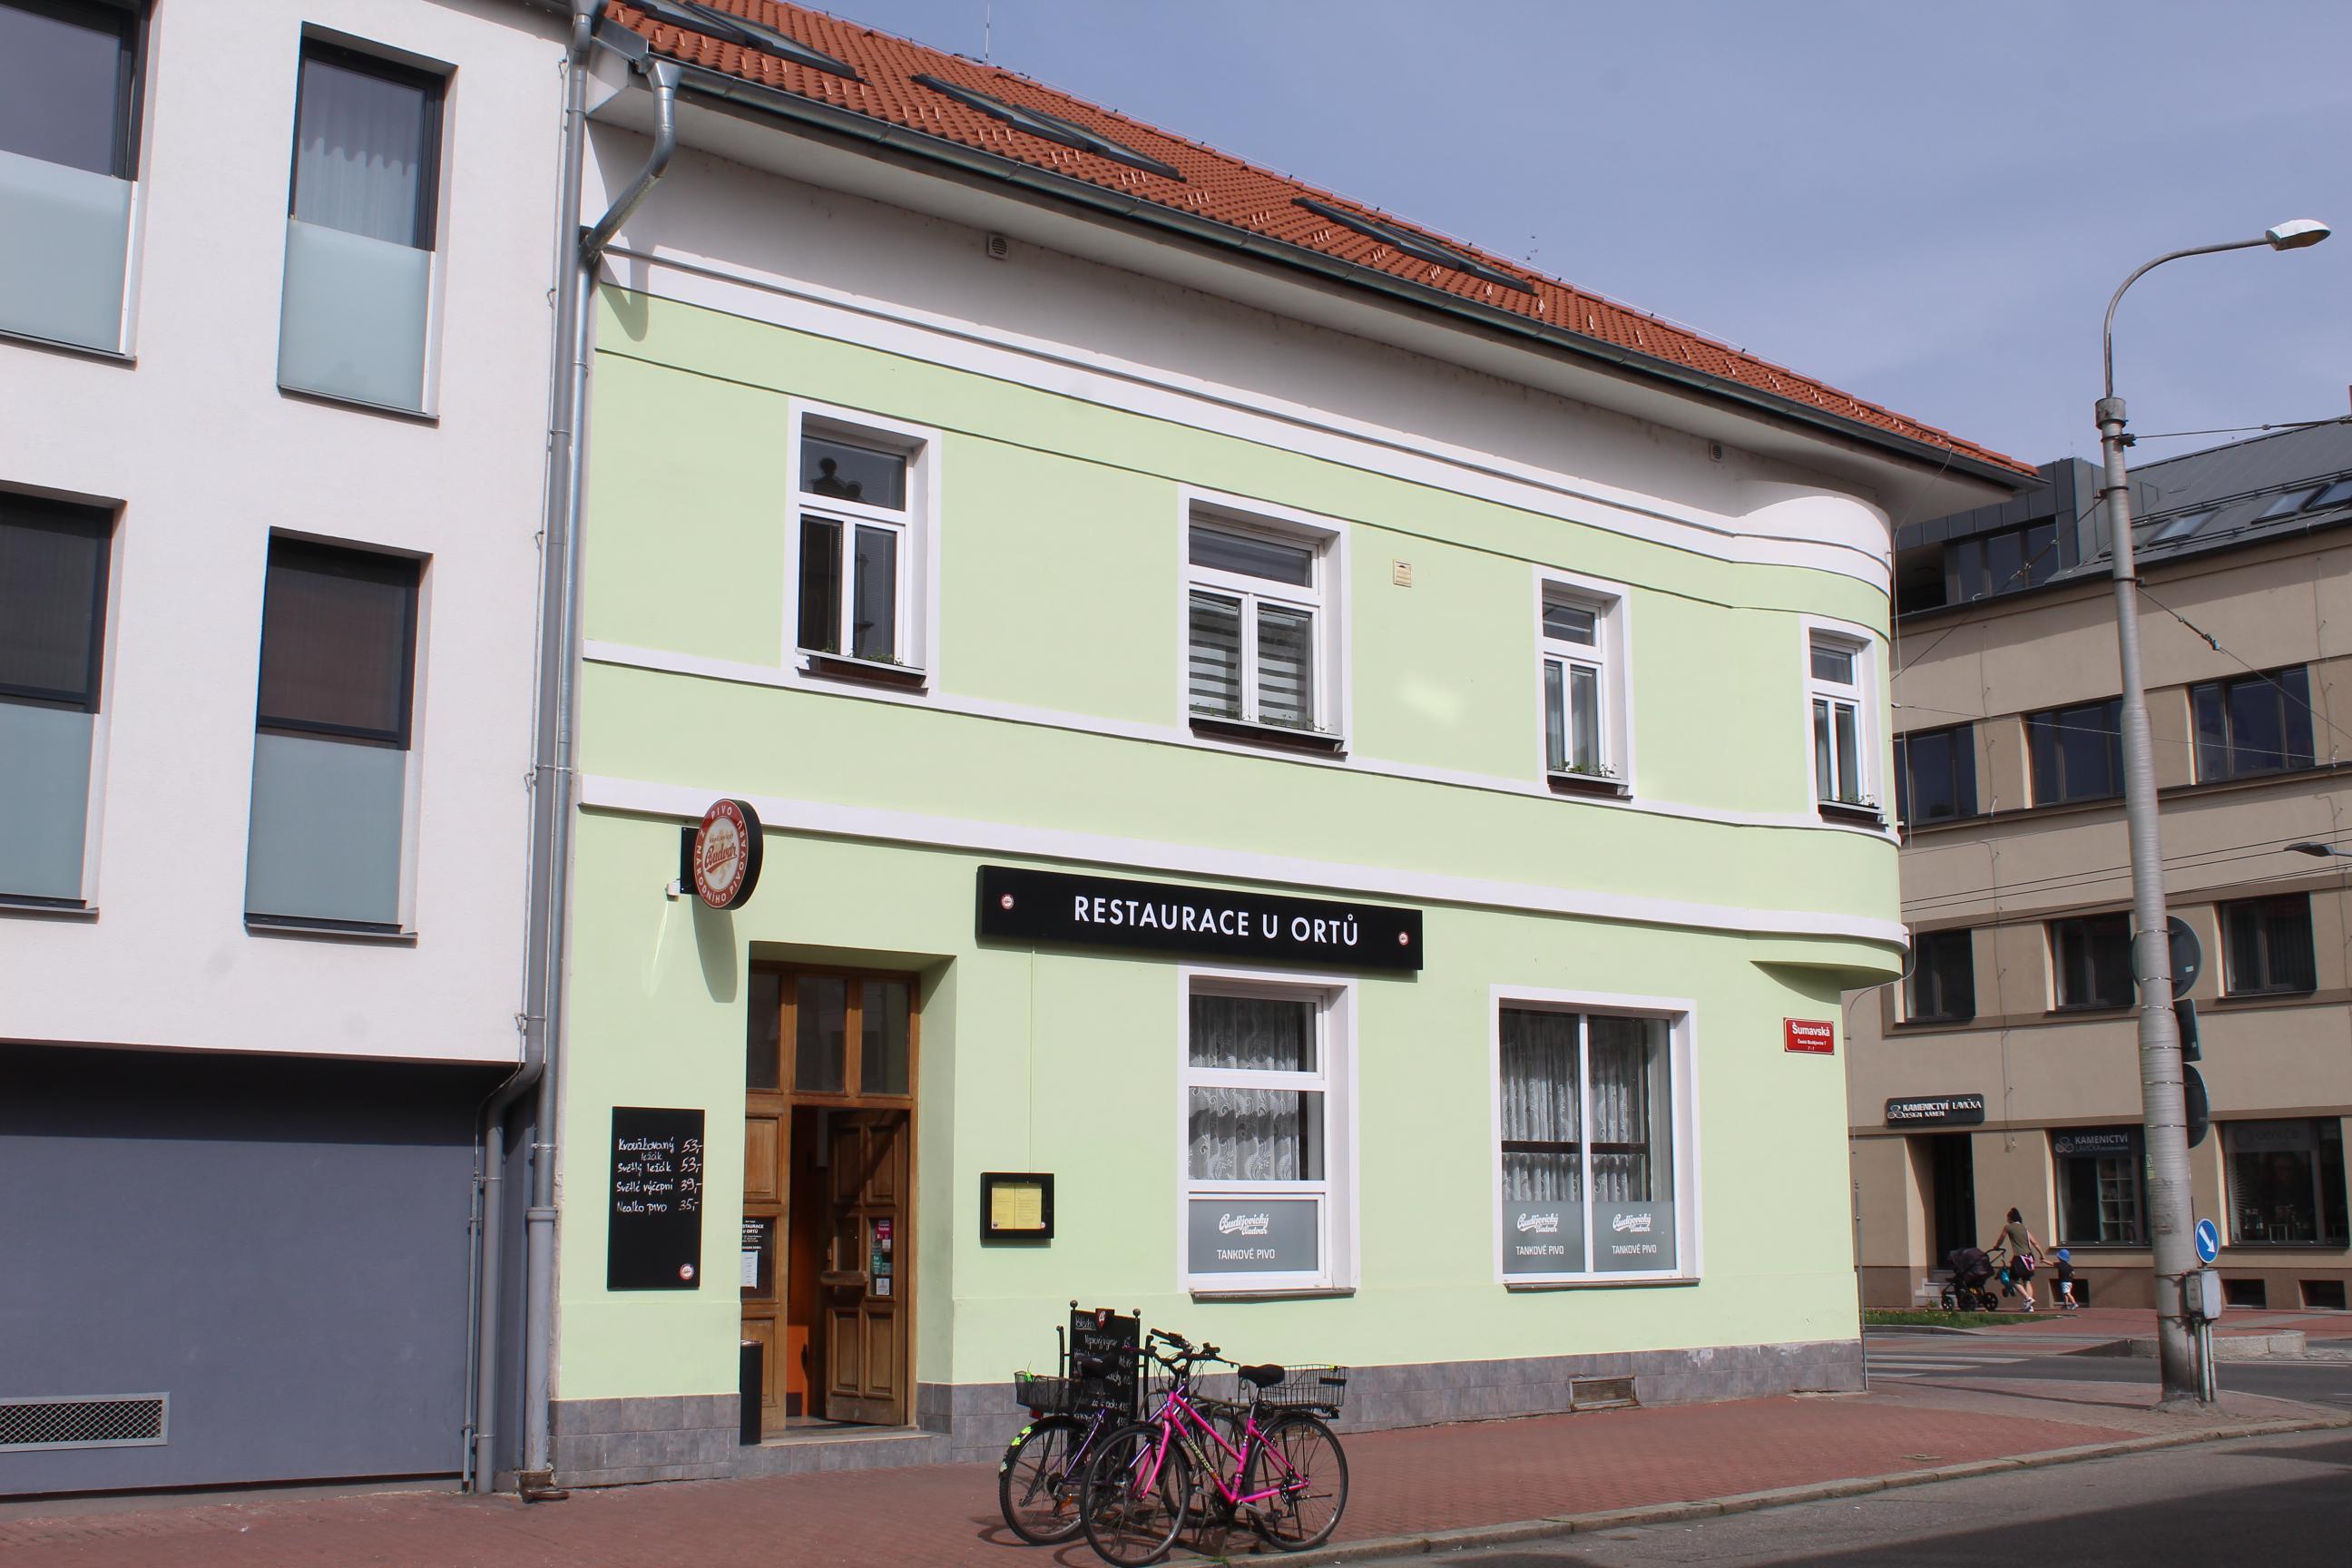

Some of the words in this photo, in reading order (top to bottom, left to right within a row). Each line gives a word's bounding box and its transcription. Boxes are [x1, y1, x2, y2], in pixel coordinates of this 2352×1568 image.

[710, 805, 732, 819] PIVO
[1074, 895, 1249, 936] RESTAURACE
[1262, 914, 1279, 938] U
[1290, 913, 1358, 946] ORTŮ
[1792, 1022, 1830, 1037] Šumavská
[1902, 1099, 1949, 1112] KAMENICTVÍ
[1952, 1098, 1983, 1110] LAVIČKA
[2074, 1132, 2128, 1144] KAMENICTVÍ
[641, 1152, 662, 1161] ležák
[617, 1162, 642, 1177] Světlý
[647, 1161, 672, 1172] ležák
[616, 1181, 641, 1193] Světlé
[643, 1179, 673, 1196] výčepní
[616, 1200, 645, 1213] Nealko
[1216, 1248, 1254, 1259] TANKOVÉ
[1257, 1249, 1276, 1259] PIVO
[1515, 1244, 1547, 1256] TANKOVÉ
[1548, 1245, 1564, 1255] PIVO
[1611, 1243, 1641, 1255] TANKOVÉ
[1642, 1244, 1657, 1254] PIVO
